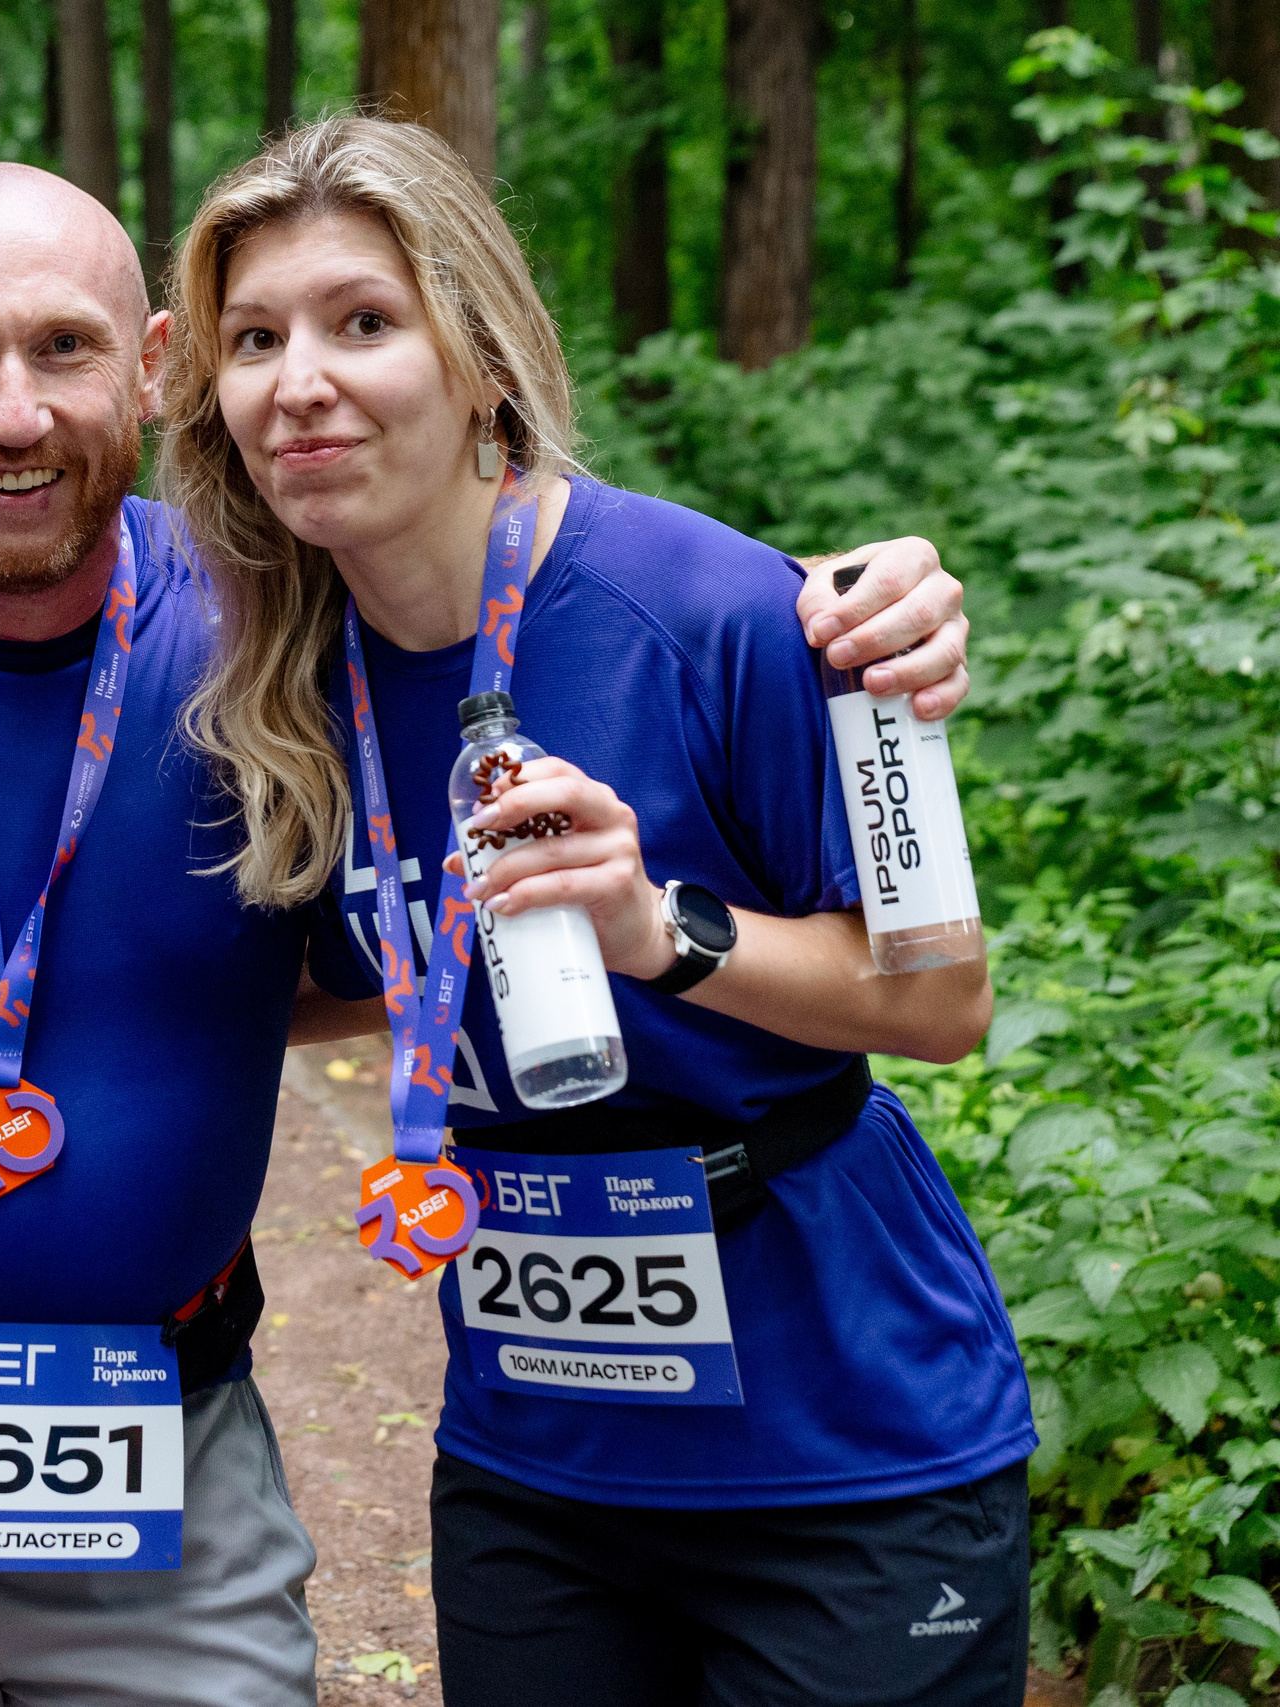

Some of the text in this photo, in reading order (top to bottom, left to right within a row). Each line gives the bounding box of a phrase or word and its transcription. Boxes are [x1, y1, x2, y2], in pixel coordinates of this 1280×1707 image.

[94, 667, 108, 697] Парк
[104, 652, 120, 700] Горького
[871, 707, 922, 870] SPORT
[855, 758, 900, 906] IPSUM
[437, 968, 455, 1005] БЕГ
[603, 1176, 656, 1197] Парк
[607, 1195, 695, 1218] Горького
[472, 1246, 698, 1327] 2625
[93, 1347, 138, 1367] Парк
[509, 1353, 558, 1377] 10КМ
[560, 1361, 658, 1383] КЛАСТЕР
[92, 1366, 167, 1387] Горького
[908, 1617, 983, 1637] DEMIX
